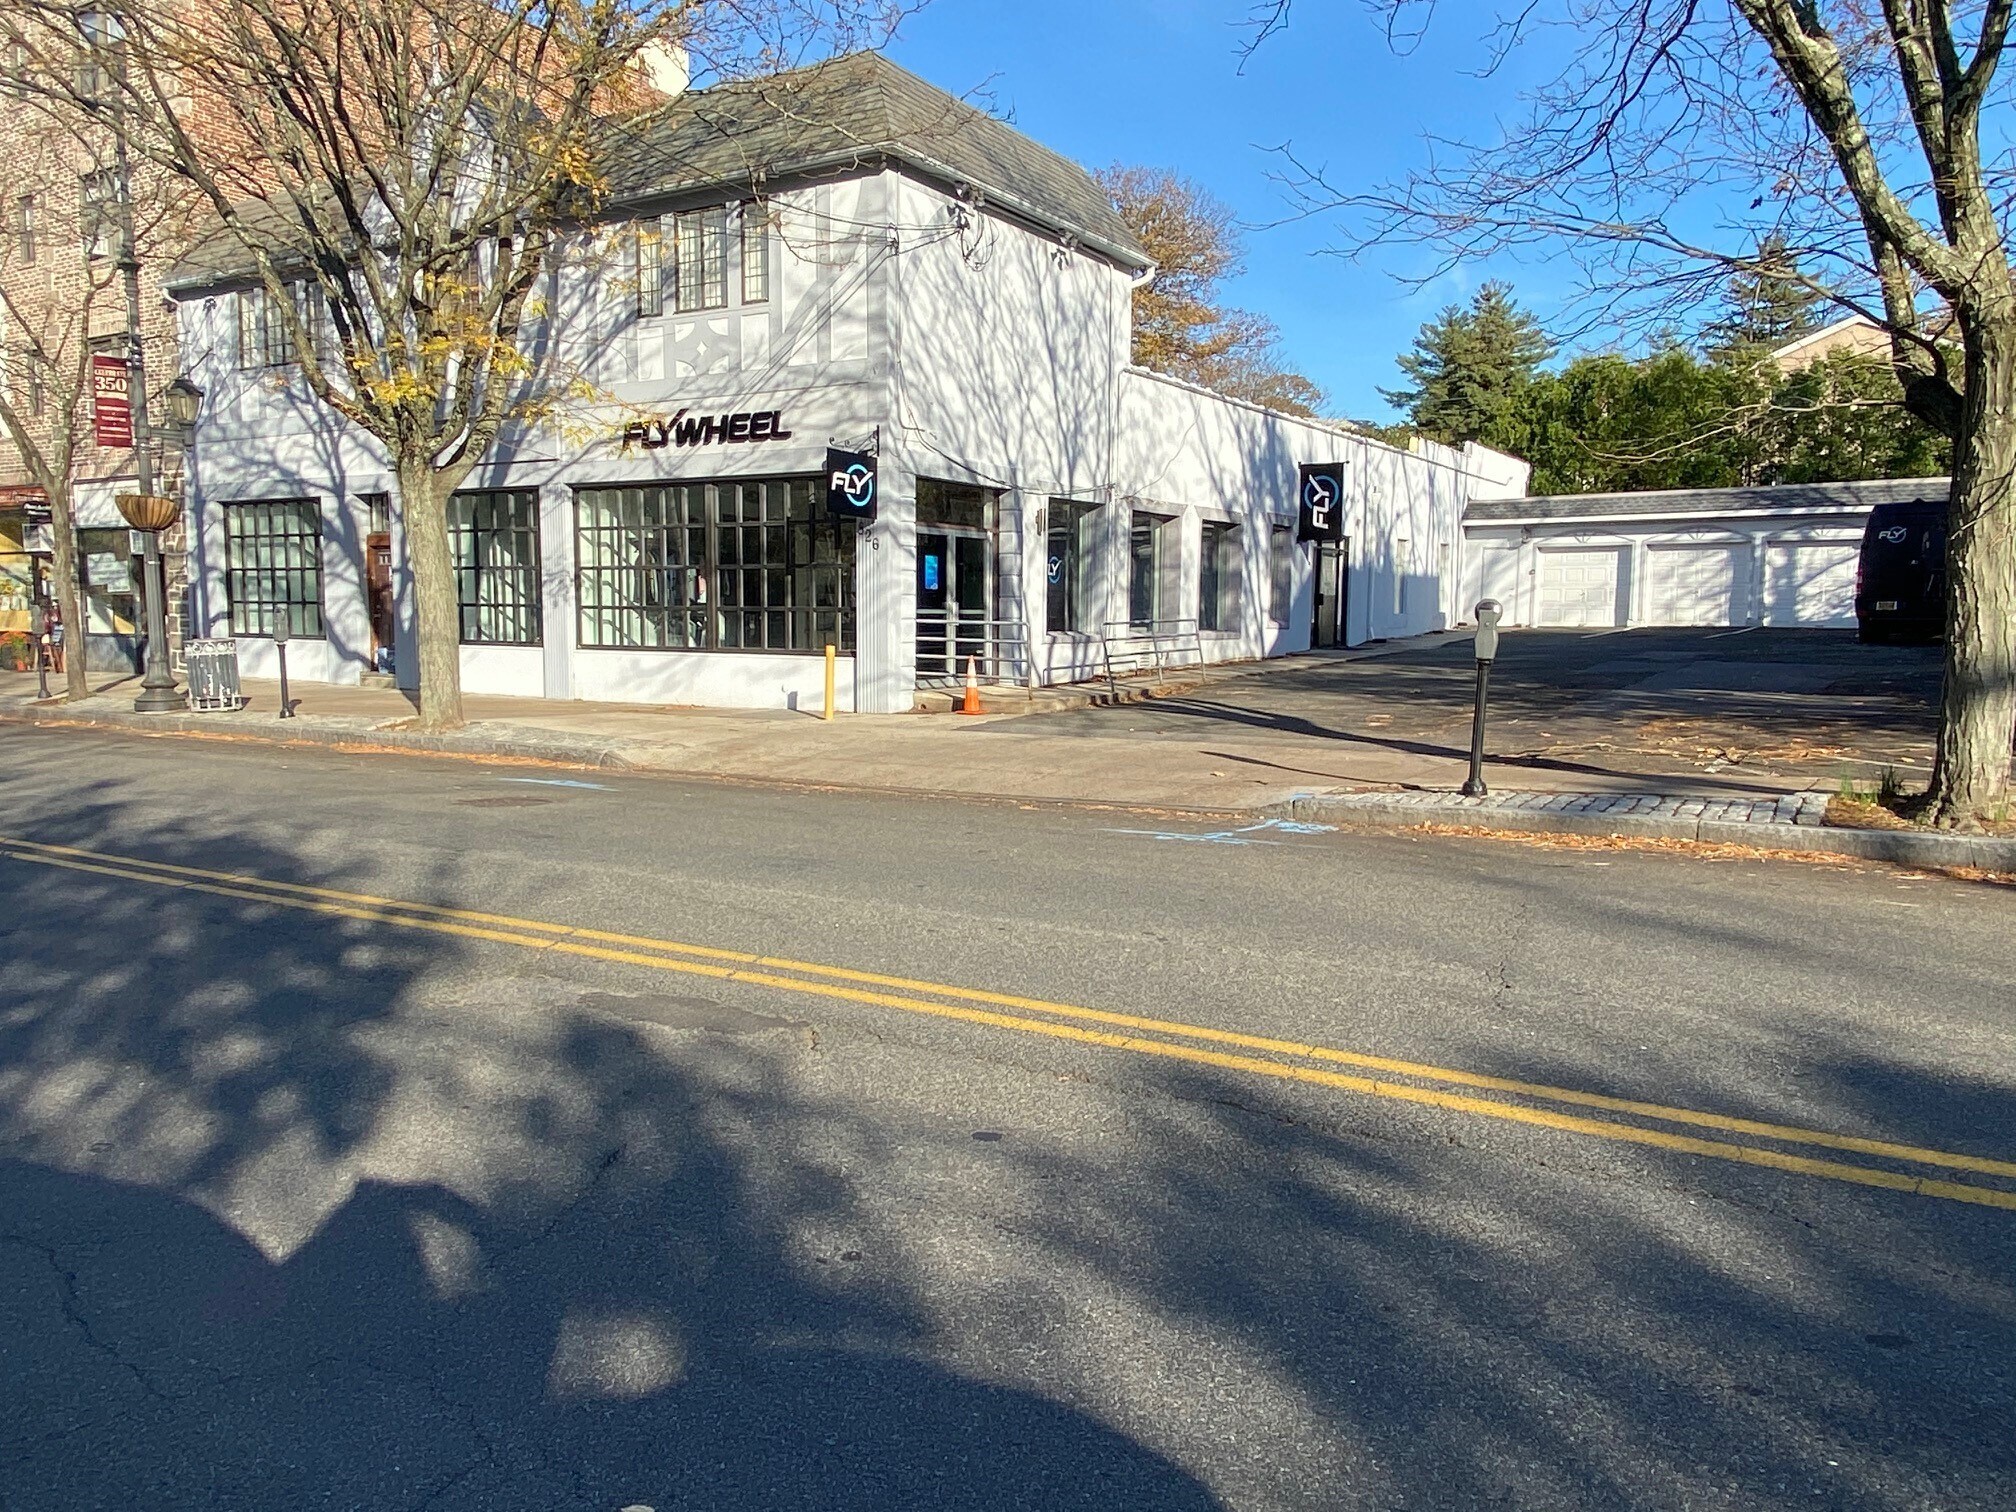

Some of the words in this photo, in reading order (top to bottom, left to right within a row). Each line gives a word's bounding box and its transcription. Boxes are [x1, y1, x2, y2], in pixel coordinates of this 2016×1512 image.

[94, 376, 128, 392] 350
[622, 408, 792, 450] FLYWHEEL
[831, 471, 874, 495] FLY
[1308, 474, 1330, 530] FLY
[1878, 527, 1907, 539] FLY
